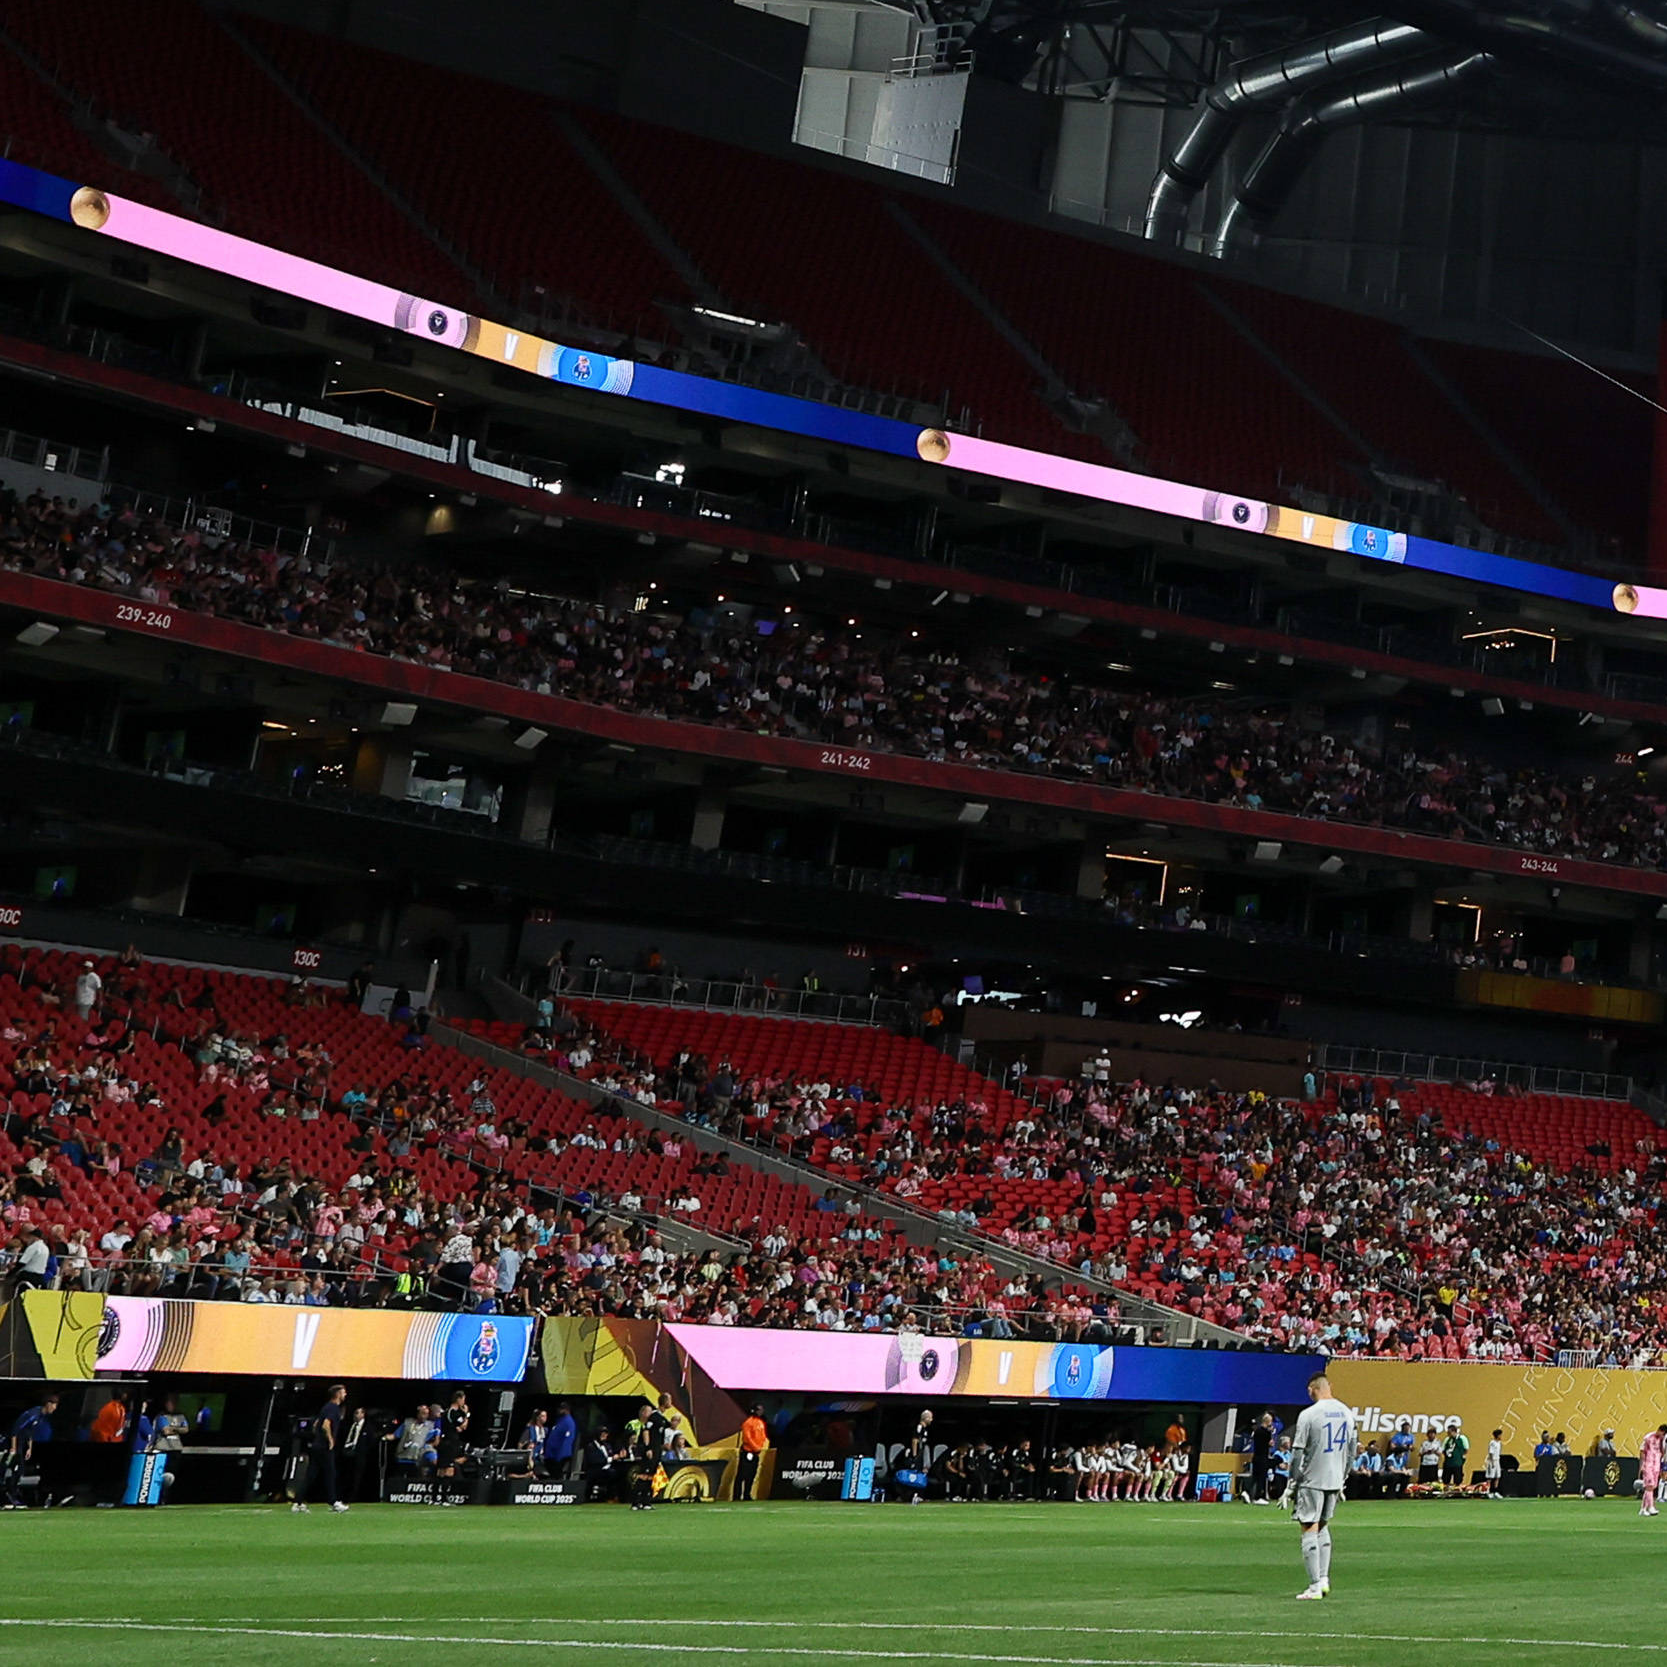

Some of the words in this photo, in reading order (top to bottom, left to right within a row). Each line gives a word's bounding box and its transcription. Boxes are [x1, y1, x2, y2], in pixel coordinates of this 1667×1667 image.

[504, 332, 520, 361] V
[1301, 515, 1315, 540] V
[115, 604, 172, 630] 239-240
[821, 751, 872, 770] 241-242
[1520, 857, 1560, 874] 243-244
[292, 950, 321, 968] 130C
[292, 1312, 320, 1370] V
[998, 1350, 1013, 1385] V
[1350, 1406, 1463, 1434] Hisense
[1322, 1420, 1348, 1453] 14
[796, 1460, 813, 1469] FIFA
[814, 1460, 834, 1469] CLUB
[138, 1454, 156, 1504] POWERADE
[407, 1483, 427, 1492] FIFA
[528, 1484, 544, 1493] FIFA
[544, 1484, 563, 1493] CLUB
[390, 1494, 421, 1503] WORLD
[515, 1494, 541, 1504] WORLD
[540, 1494, 555, 1504] CUP
